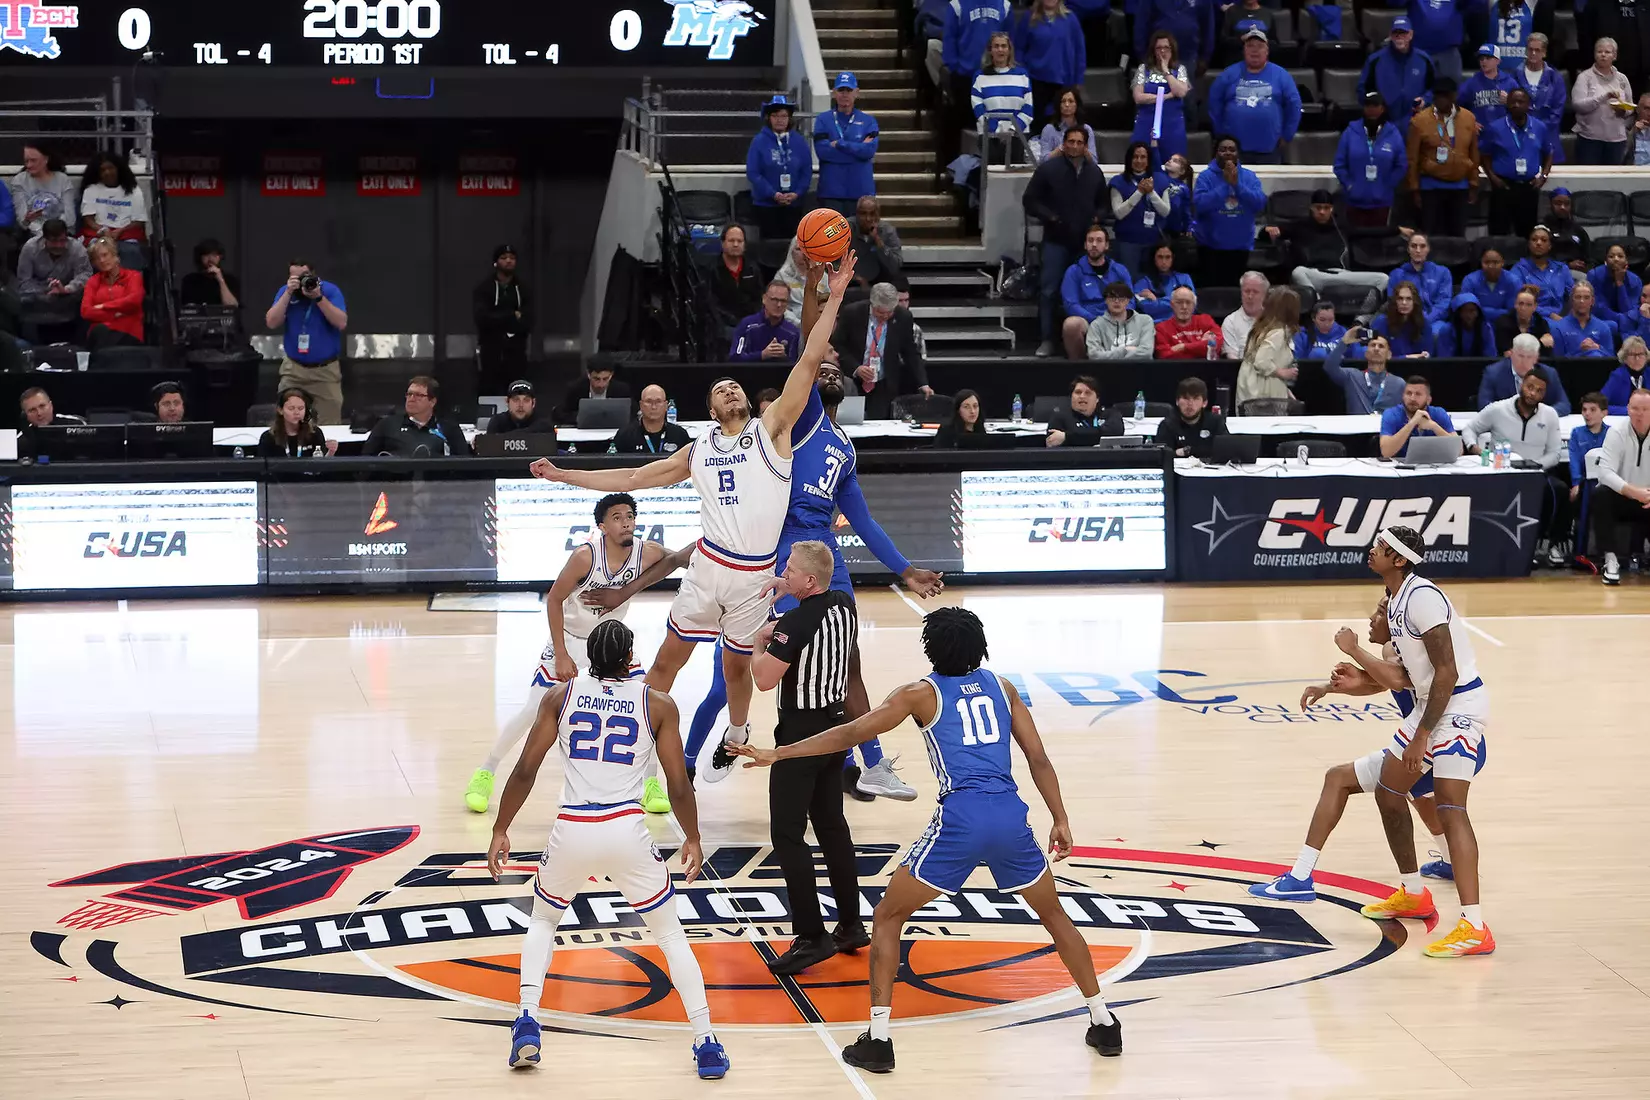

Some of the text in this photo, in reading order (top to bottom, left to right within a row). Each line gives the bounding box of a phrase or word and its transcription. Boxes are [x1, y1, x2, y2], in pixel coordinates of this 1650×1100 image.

[303, 0, 441, 38] 20:00
[117, 8, 151, 50] 0
[609, 9, 642, 51] 0
[663, 3, 752, 60] MT
[1497, 19, 1521, 43] 13
[193, 43, 228, 64] TOL
[257, 43, 272, 64] 4
[323, 43, 423, 64] PERIOD 1ST
[482, 43, 517, 64] TOL
[545, 43, 559, 64] 4
[164, 175, 217, 189] EXIT ONLY
[266, 175, 319, 189] EXIT ONLY
[362, 175, 414, 189] EXIT ONLY
[462, 175, 513, 189] EXIT ONLY
[504, 439, 528, 451] POSS.
[704, 453, 748, 467] LOISIANA
[718, 469, 736, 492] 13
[818, 455, 843, 495] 31
[718, 495, 739, 506] TEH
[348, 542, 407, 556] BSN SPORTS
[1253, 550, 1469, 567] CONFERENCEUSA.COM ENCEUSA
[960, 682, 983, 695] KING
[576, 695, 636, 714] CRAWFORD
[1181, 702, 1400, 715] VON BRA
[956, 695, 1000, 746] 10
[1248, 712, 1400, 724] CENTE
[568, 710, 640, 766] 22
[187, 849, 338, 891] 2024
[903, 925, 971, 938] AL
